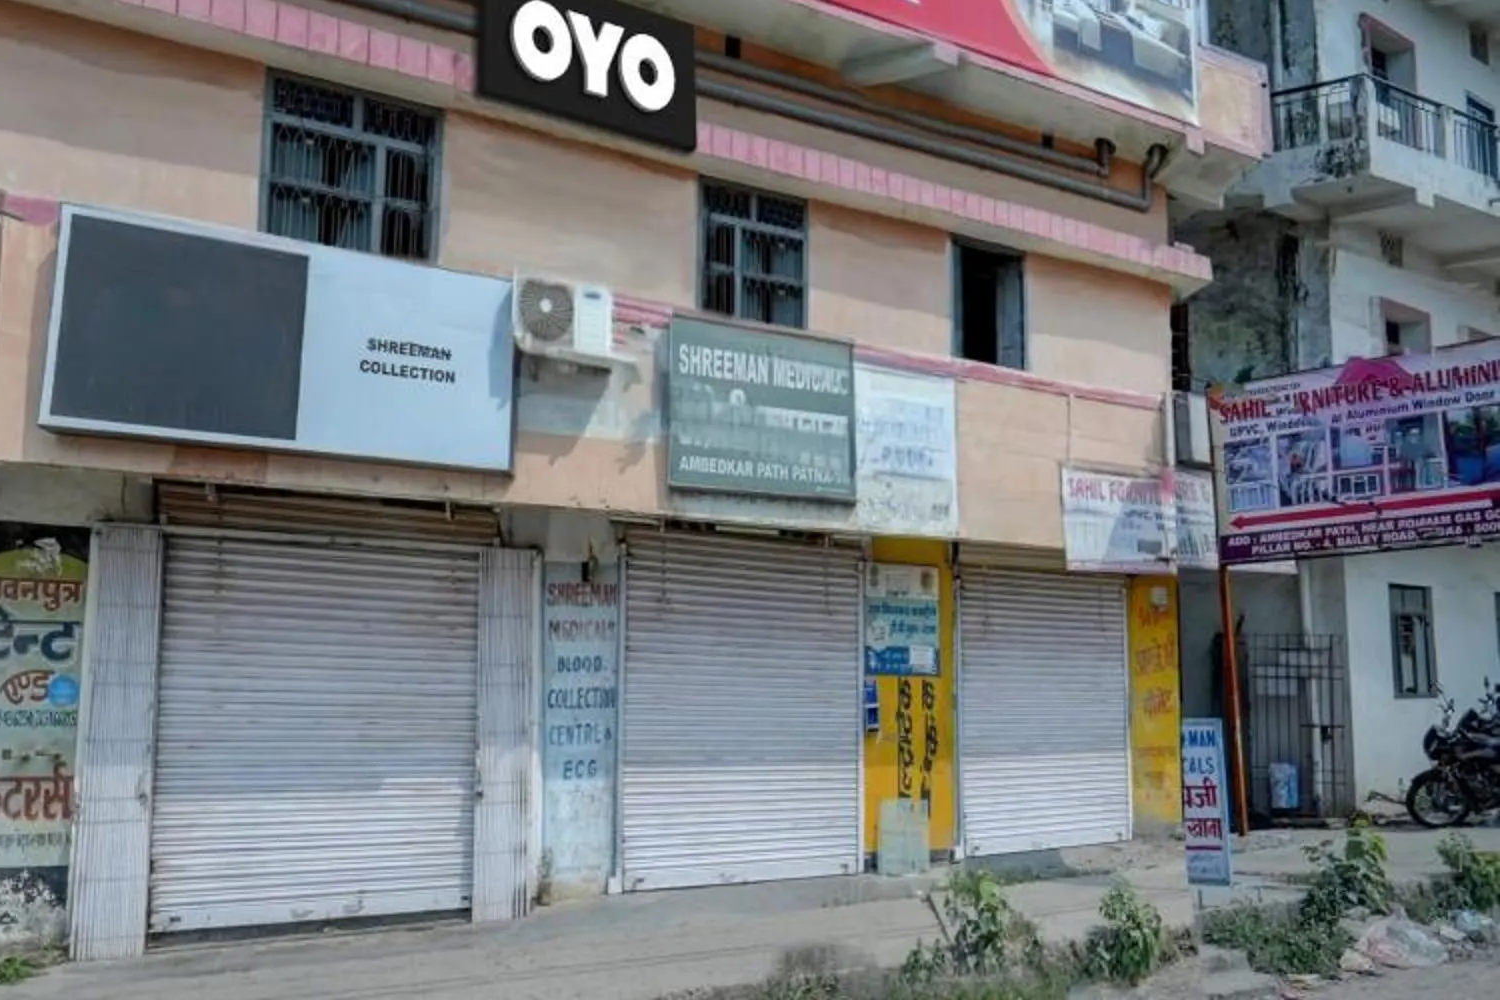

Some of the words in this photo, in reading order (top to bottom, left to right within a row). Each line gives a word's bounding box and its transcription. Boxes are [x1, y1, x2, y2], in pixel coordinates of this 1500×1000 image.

[366, 337, 452, 361] SHREEMAN
[359, 359, 456, 384] COLLECTION
[678, 344, 769, 385] SHREEMAN
[1219, 400, 1272, 424] SAHIL
[678, 455, 754, 477] AMBEDKAR
[757, 461, 789, 480] PATH
[557, 655, 603, 673] BLOOD
[1184, 728, 1216, 747] MAN
[562, 760, 598, 780] ECG
